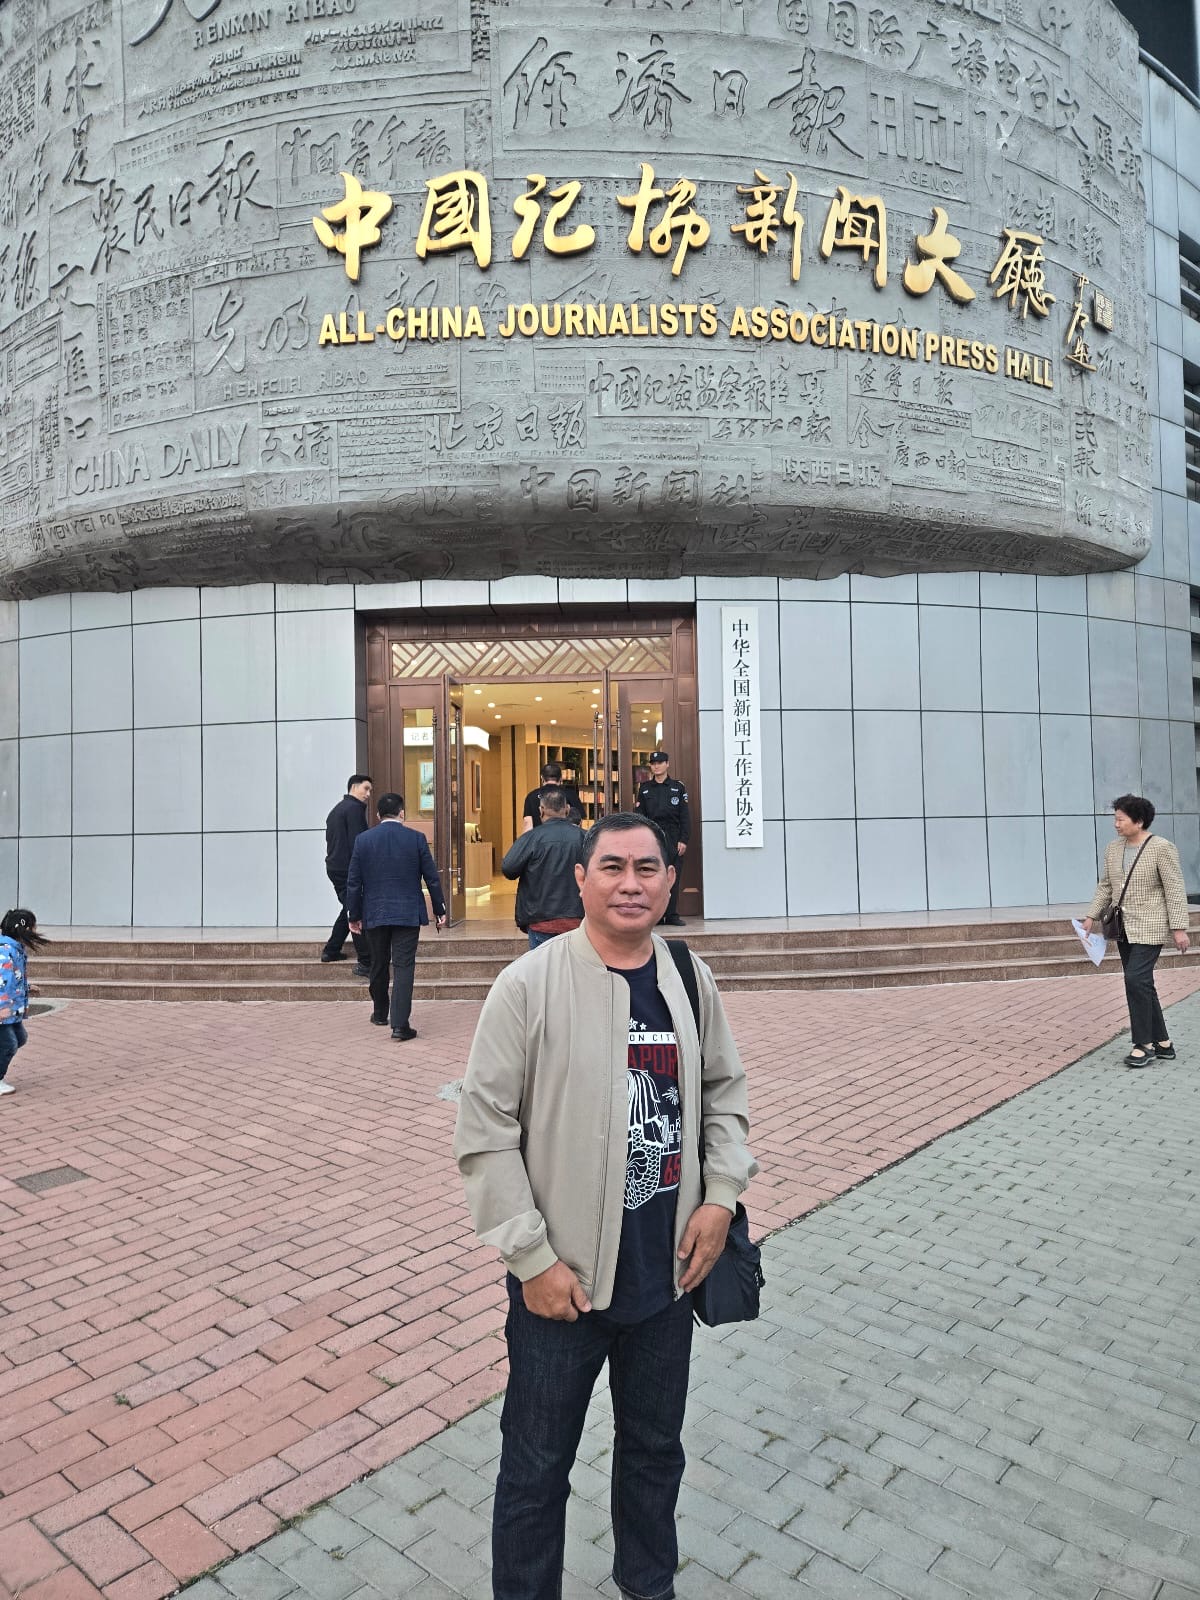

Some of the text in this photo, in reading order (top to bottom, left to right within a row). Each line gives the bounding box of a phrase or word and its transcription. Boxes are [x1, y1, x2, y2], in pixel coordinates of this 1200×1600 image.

[318, 306, 486, 345] ALL-CHINA
[499, 303, 718, 338] JOURNALISTS
[730, 306, 918, 360] ASSOCIATION
[925, 334, 999, 375] PRESS
[1005, 349, 1054, 389] HALL
[70, 422, 249, 496] CHINA DAILY
[732, 618, 754, 836] 中华全国新闻工作者协会
